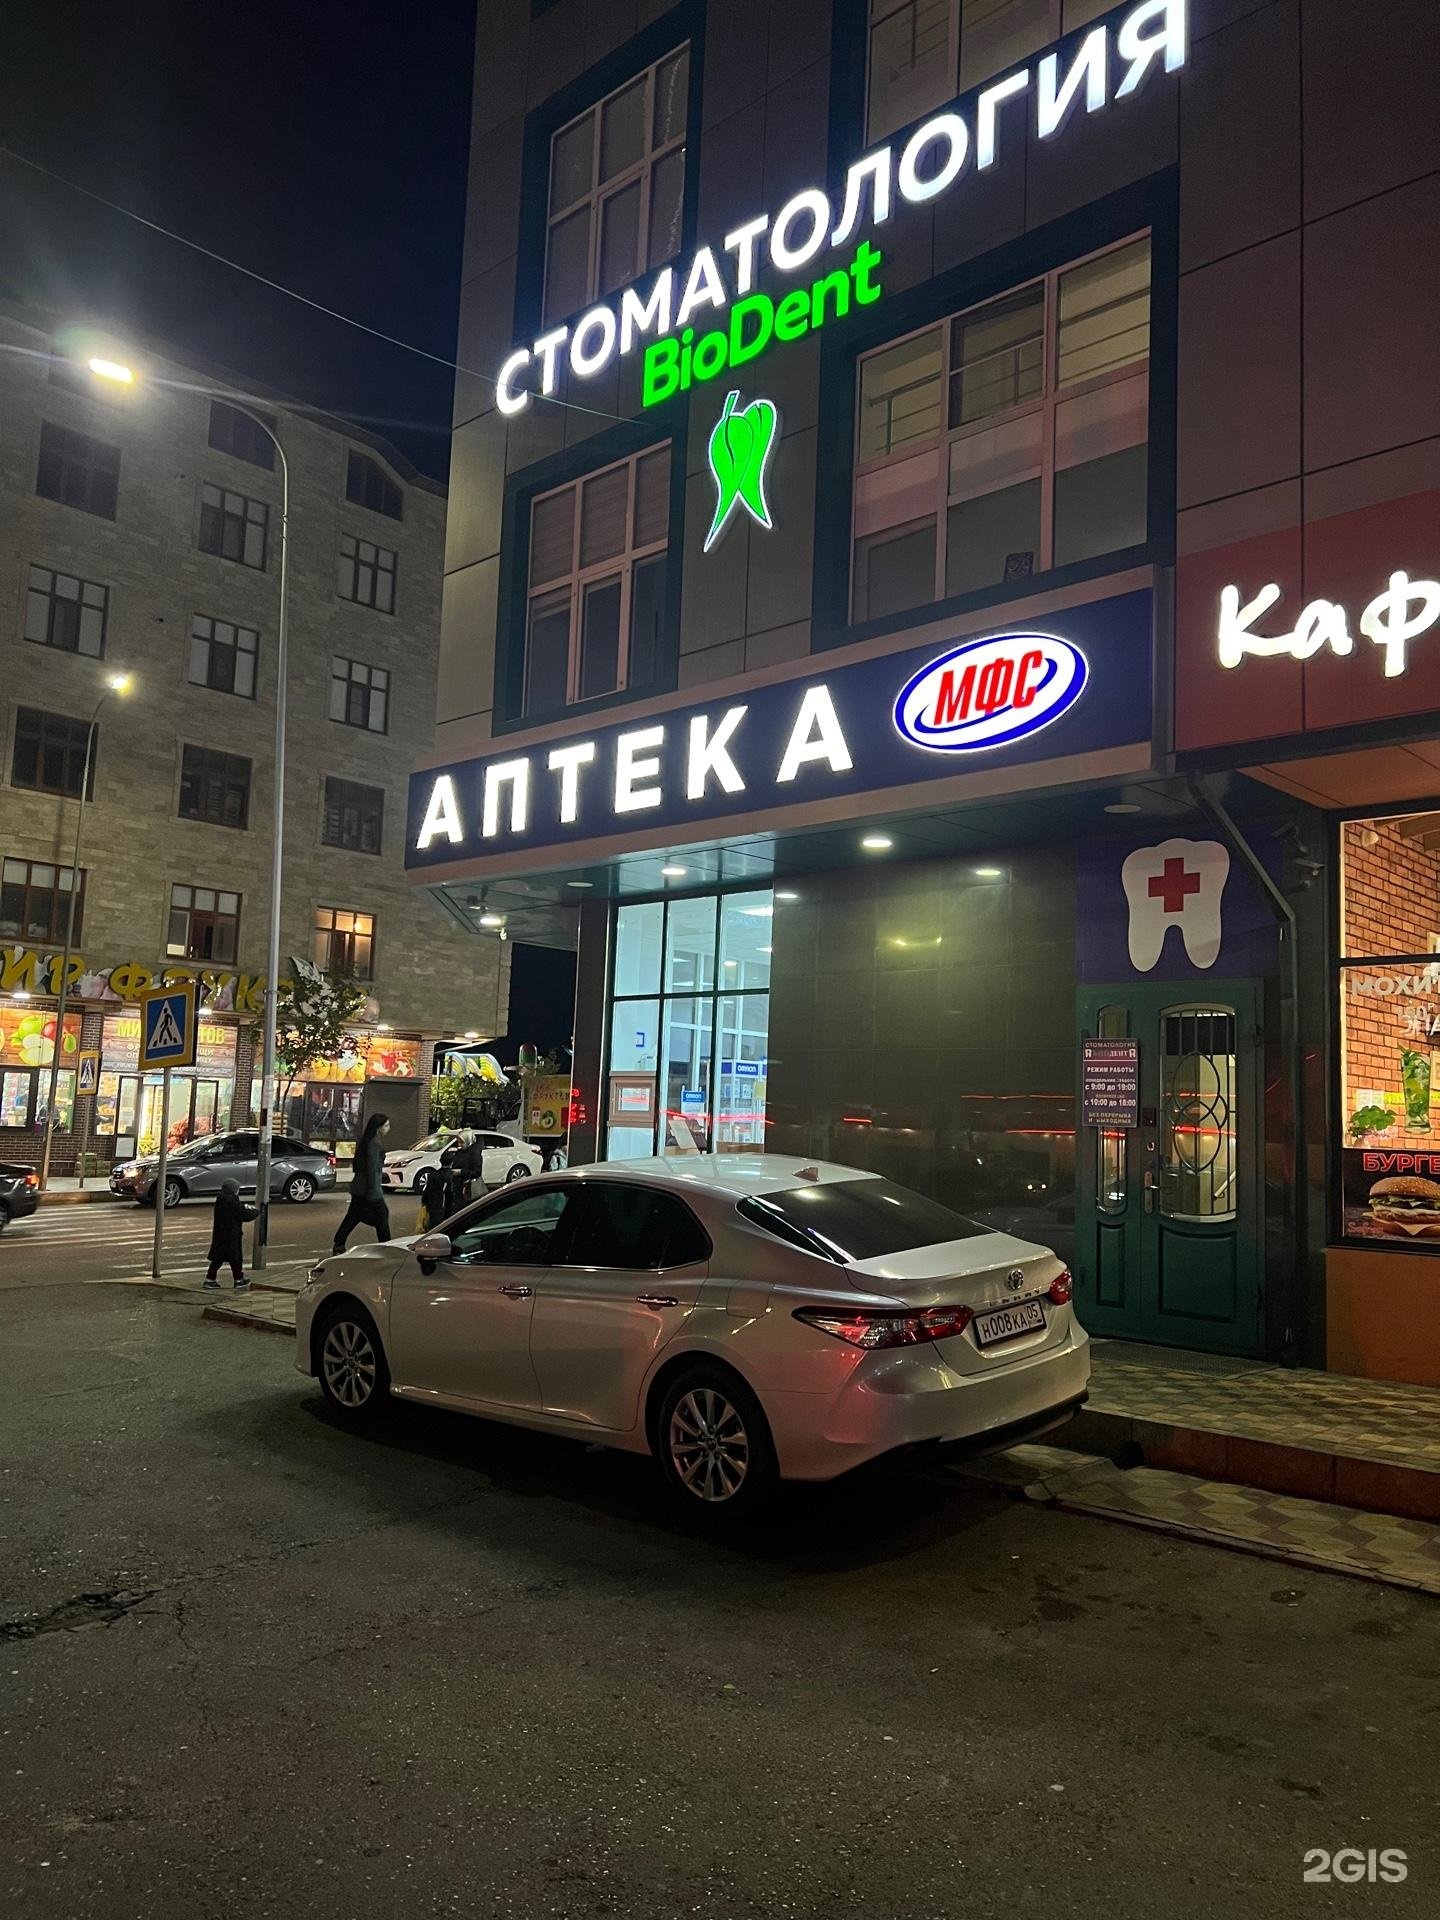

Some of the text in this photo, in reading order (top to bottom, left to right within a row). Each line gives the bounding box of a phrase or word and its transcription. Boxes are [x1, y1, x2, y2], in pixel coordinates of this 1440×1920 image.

[495, 0, 1186, 414] СТОМАТОЛОГИЯ
[642, 240, 881, 408] BioDent
[1219, 570, 1440, 677] Каф
[934, 650, 1042, 726] МФС
[415, 684, 854, 850] АПТЕКА
[1351, 974, 1440, 999] МОХИ
[1091, 1083, 1106, 1091] 9:00
[1117, 1083, 1136, 1091] 19:00
